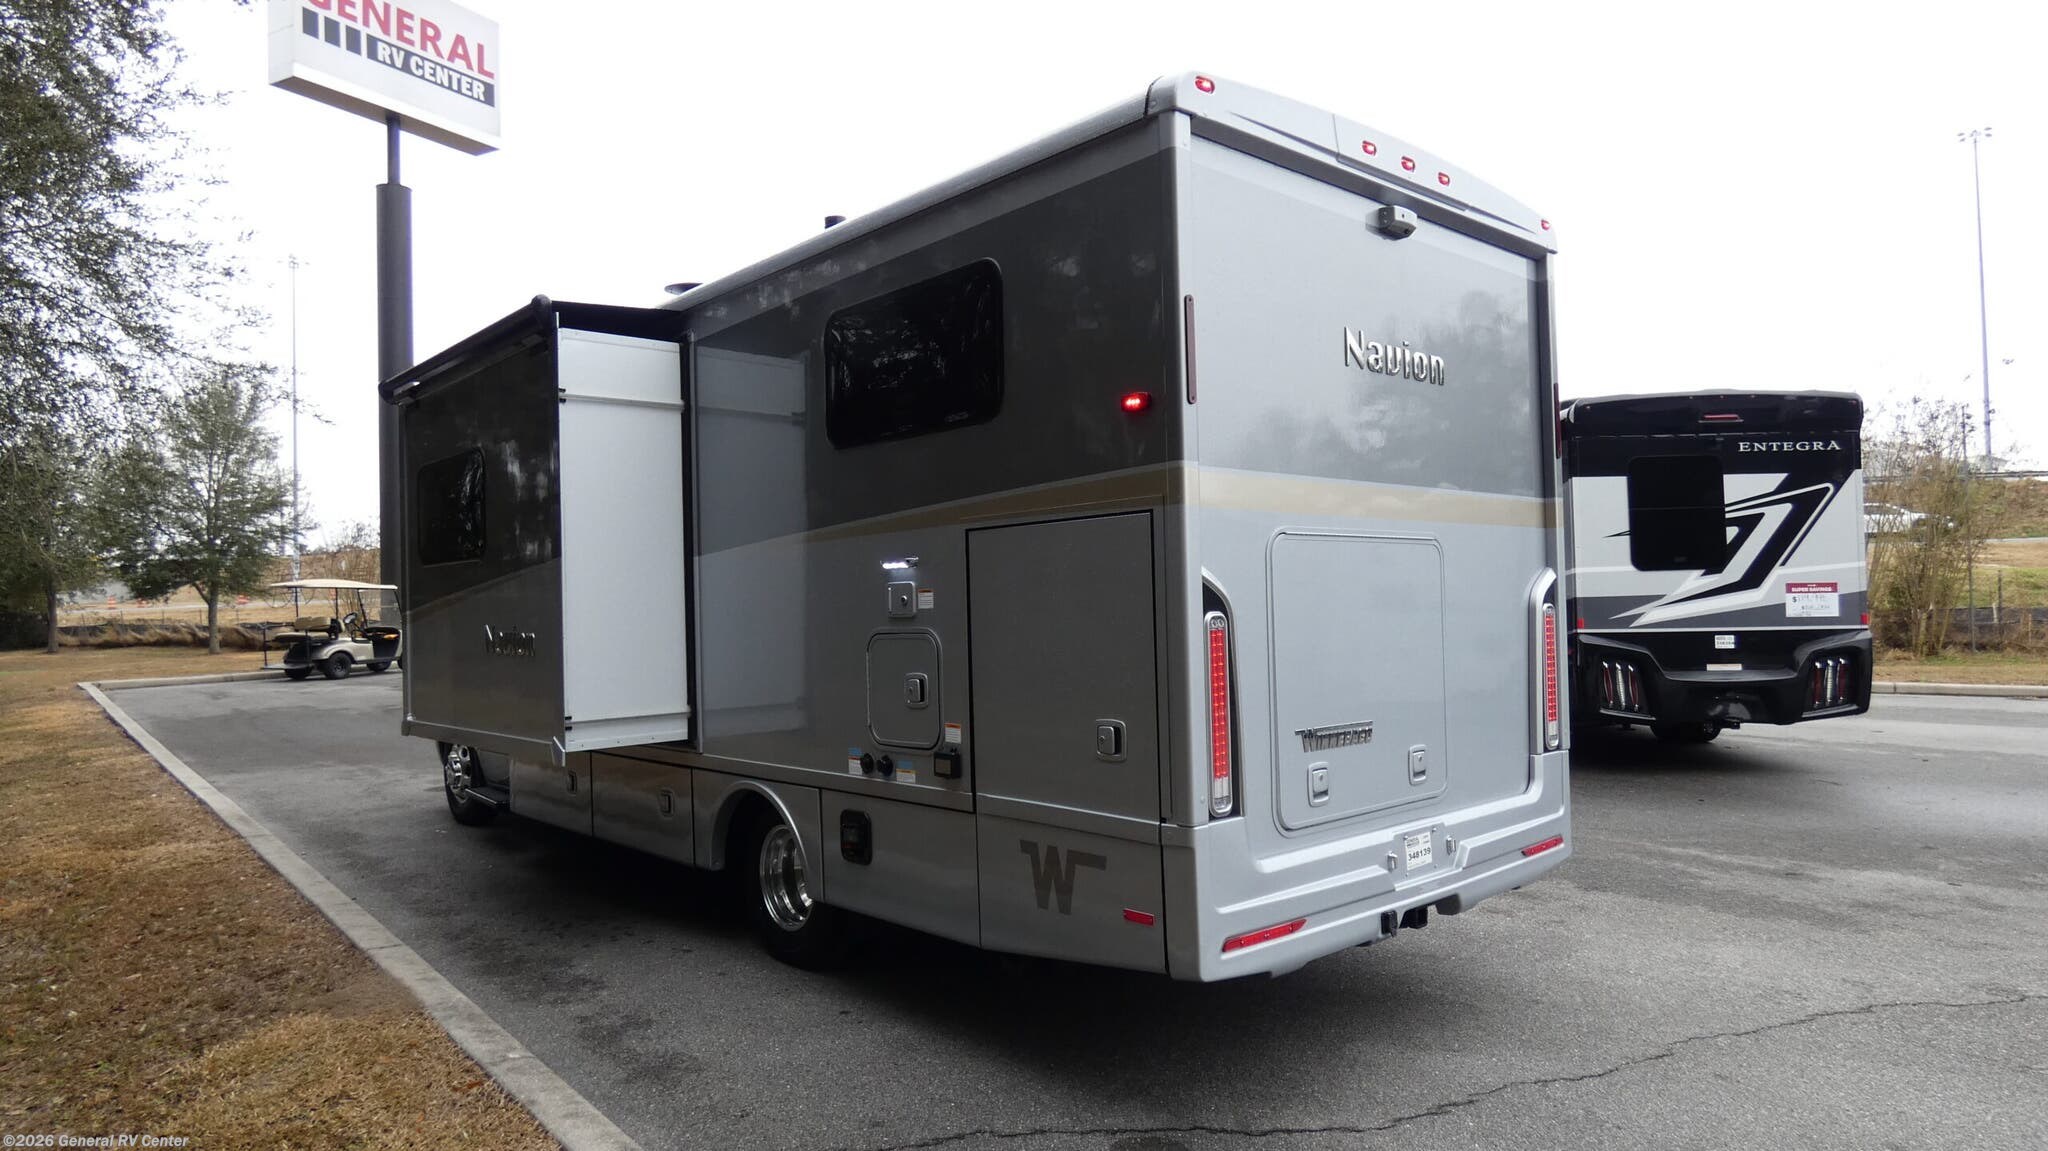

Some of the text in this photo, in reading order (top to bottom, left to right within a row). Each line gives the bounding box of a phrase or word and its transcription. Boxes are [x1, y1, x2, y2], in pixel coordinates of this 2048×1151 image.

[377, 40, 486, 102] RV CENTER
[1344, 326, 1445, 386] Navion
[1738, 440, 1842, 452] ENTEGRA
